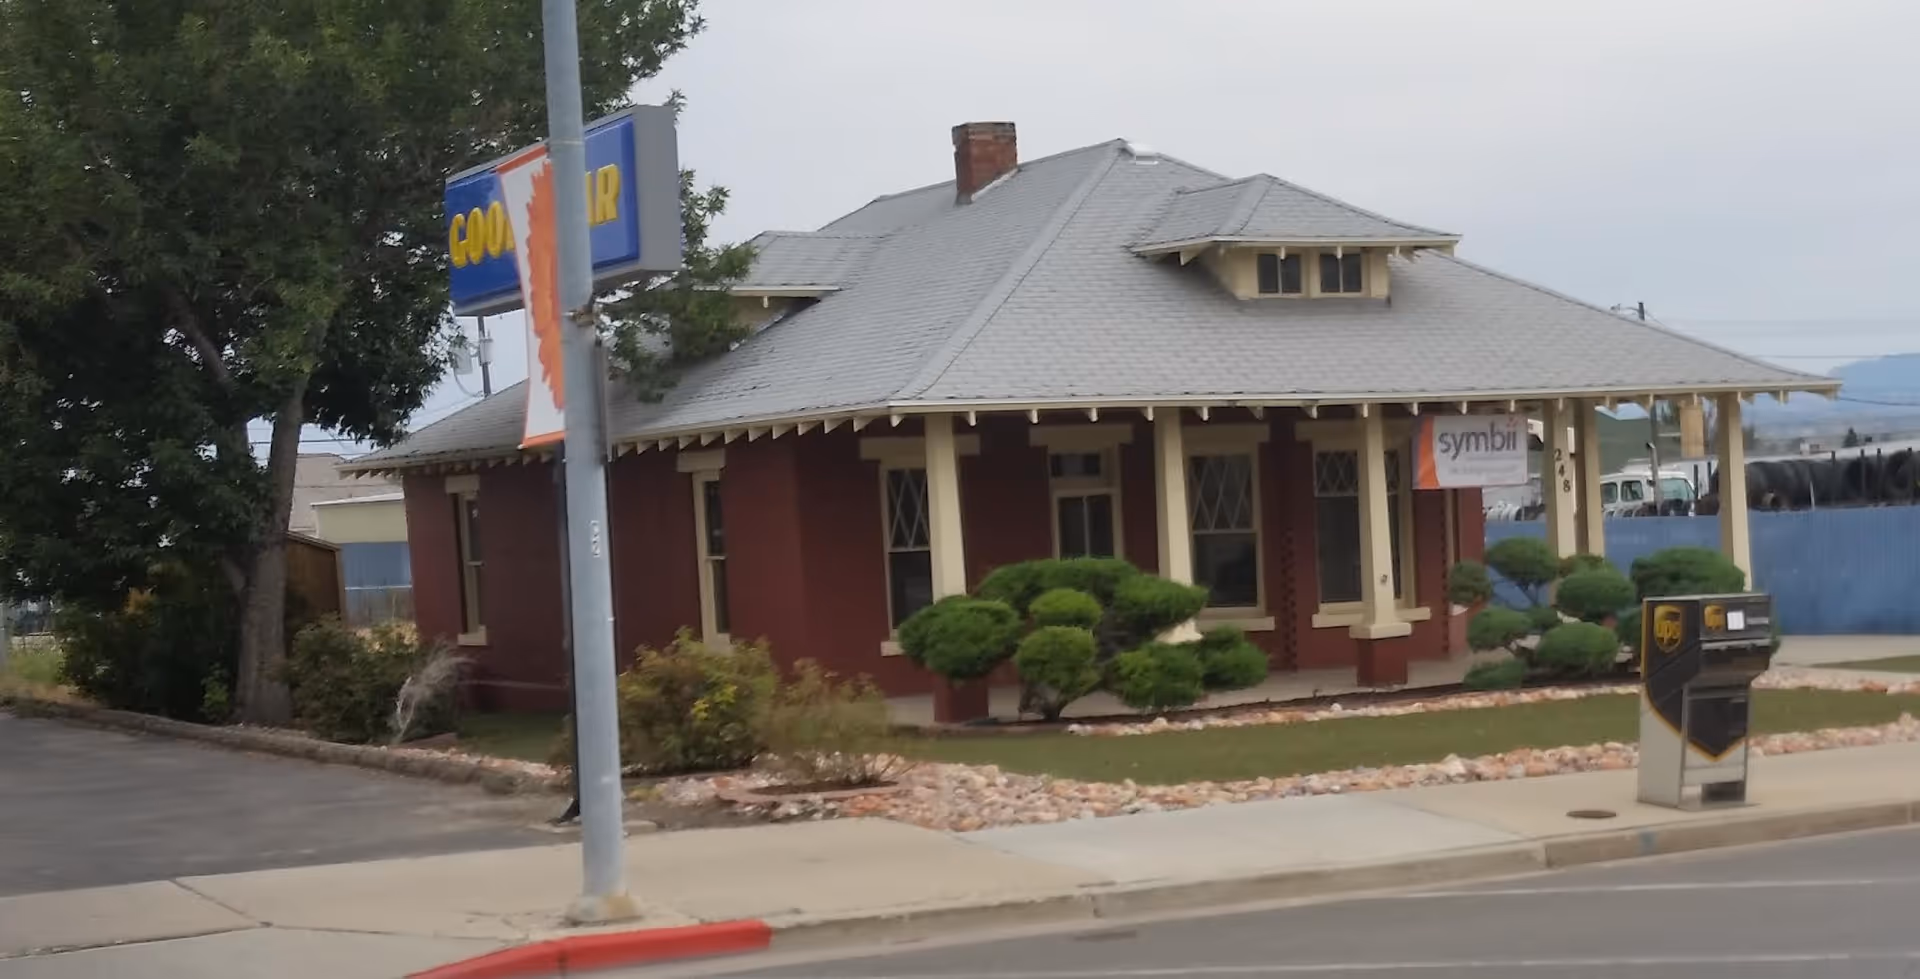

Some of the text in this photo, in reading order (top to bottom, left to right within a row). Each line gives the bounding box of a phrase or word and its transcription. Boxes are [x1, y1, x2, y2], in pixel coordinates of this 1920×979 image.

[449, 163, 621, 268] GOOR
[1438, 417, 1518, 460] symbii
[1554, 448, 1571, 493] 248
